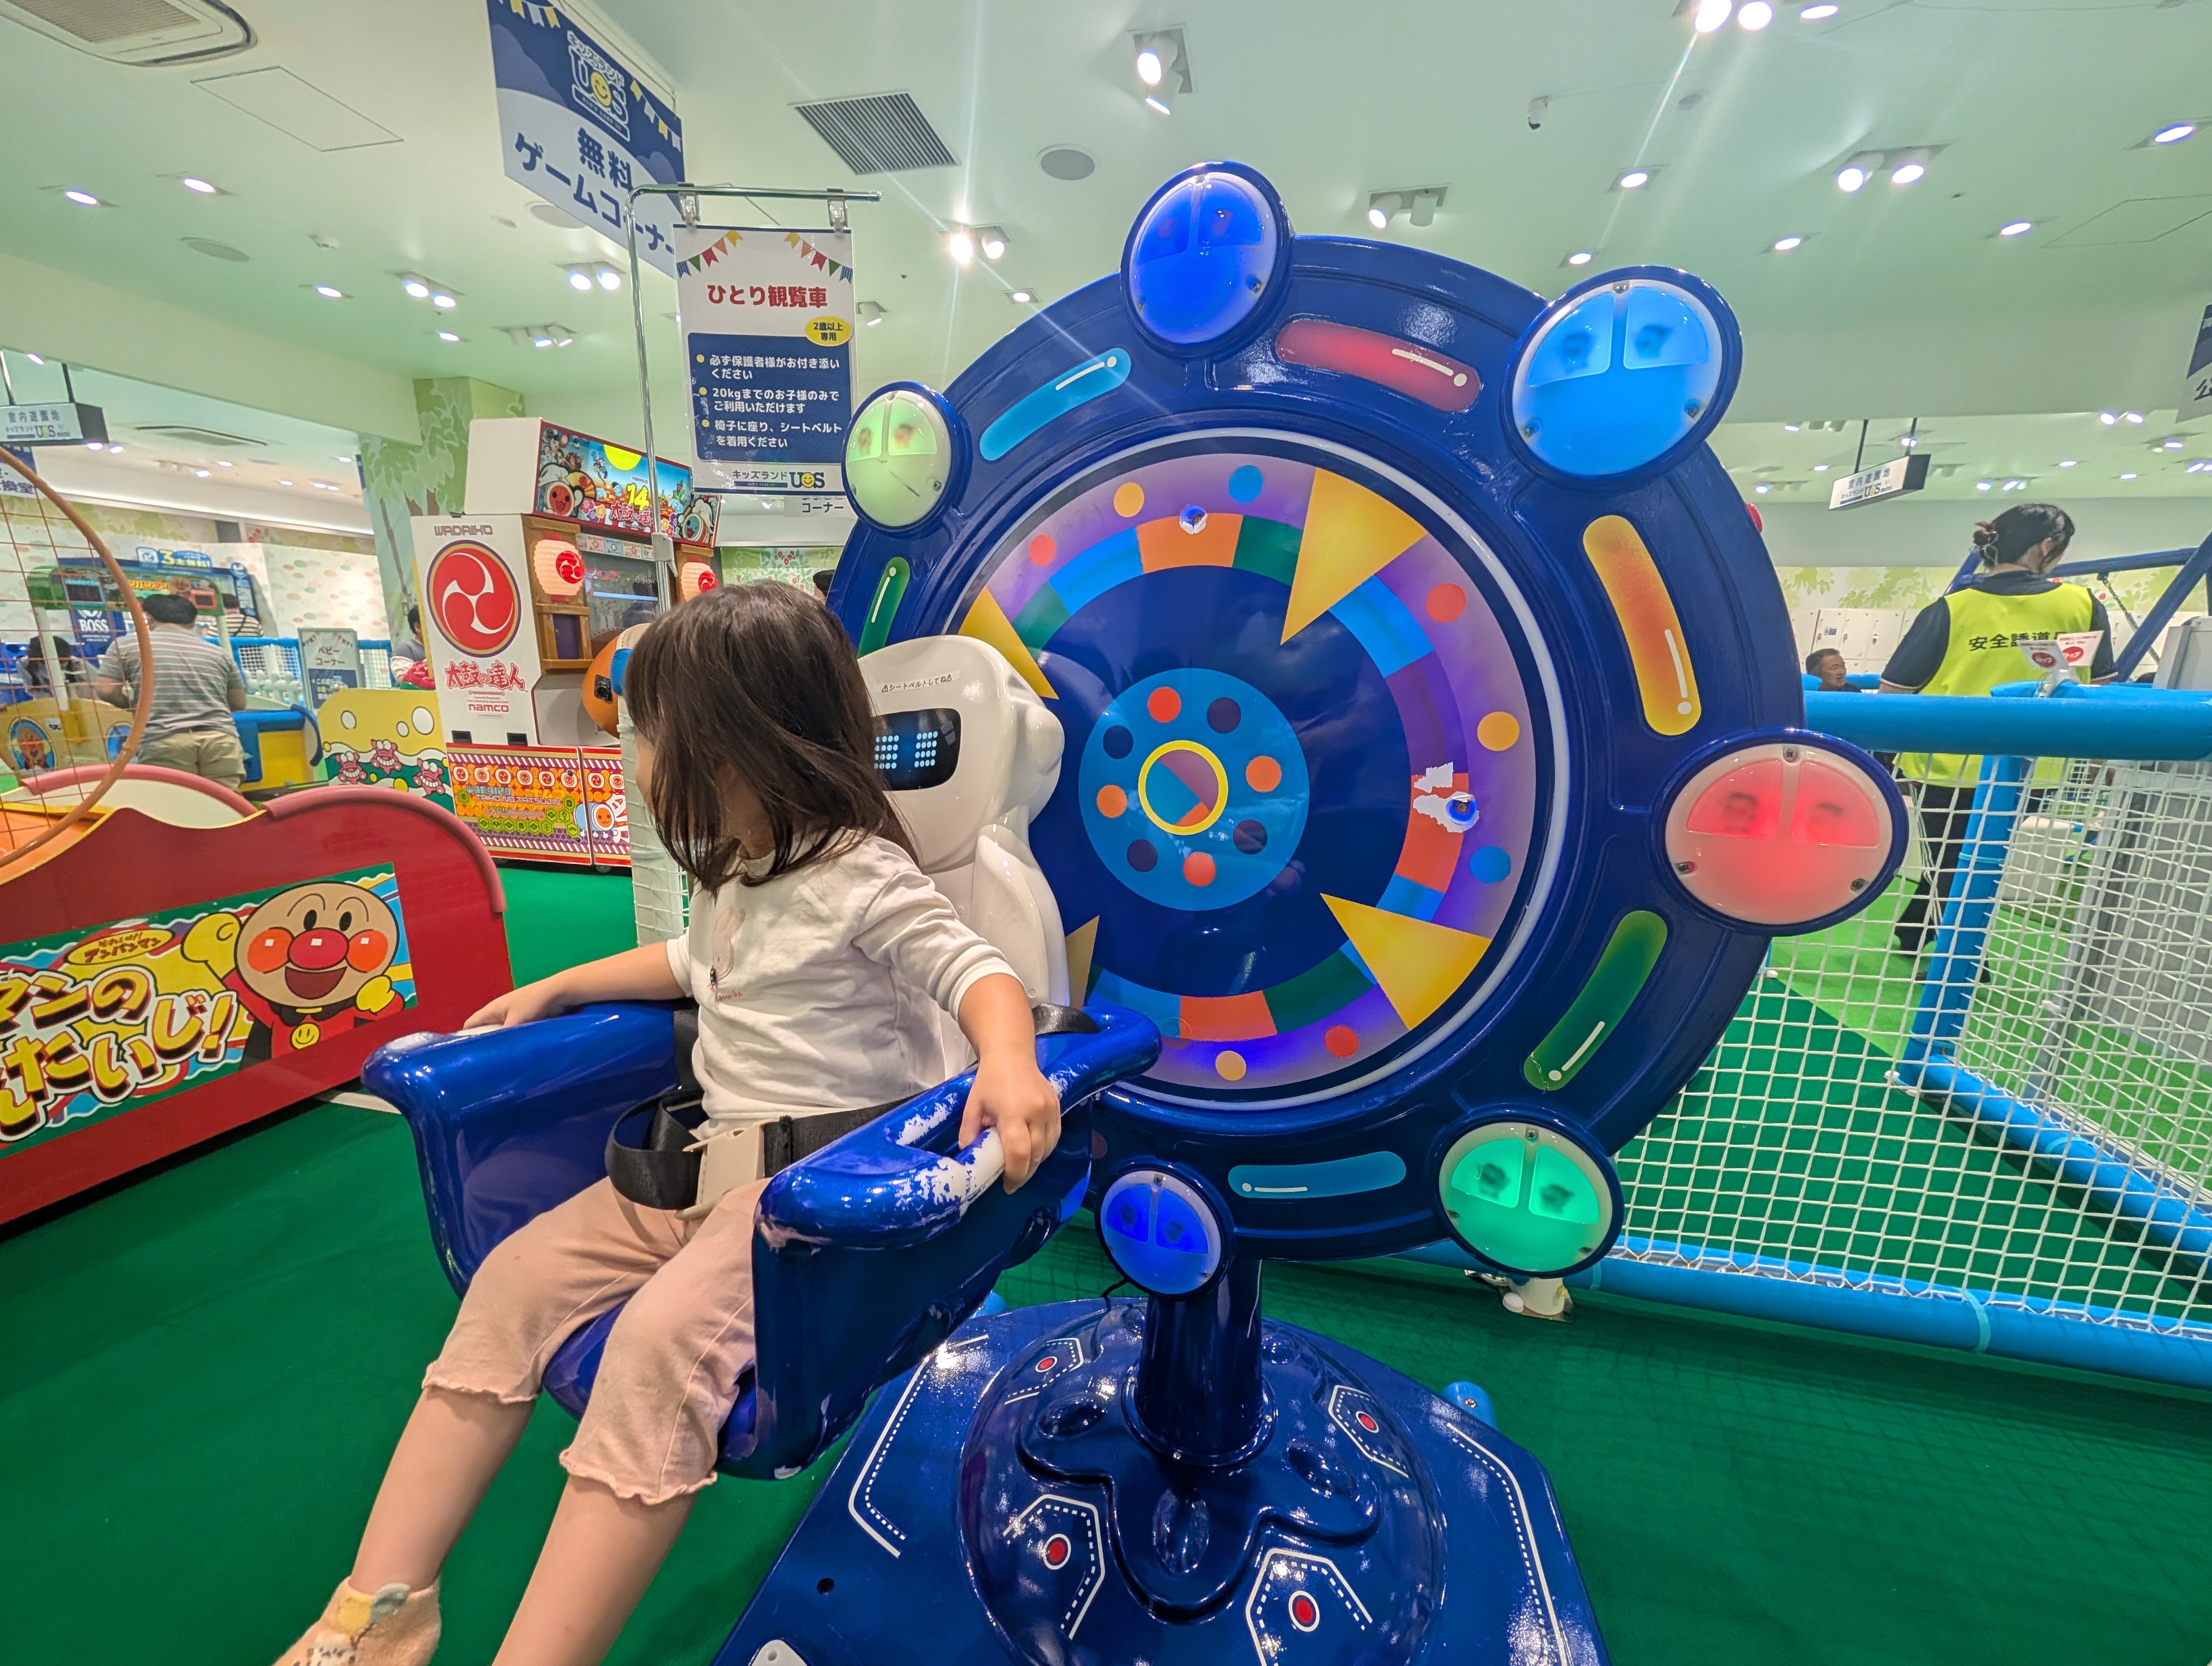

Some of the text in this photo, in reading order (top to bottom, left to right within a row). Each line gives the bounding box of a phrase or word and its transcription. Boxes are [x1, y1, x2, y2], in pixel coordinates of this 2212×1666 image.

[577, 127, 634, 191] 無料
[707, 284, 828, 309] ひとり観覧車
[813, 322, 844, 331] 2歳以上
[820, 332, 837, 341] 専用
[709, 354, 840, 369] 必ず保護者様がお付き添い
[711, 368, 753, 380] ください
[713, 388, 840, 402] 20kgまでのお子様のみで
[714, 401, 806, 414] ご利用いただけます
[715, 420, 842, 433] 椅子に座り、シートベルト
[716, 435, 788, 448] を着用ください
[732, 470, 787, 480] キッズランド
[627, 483, 650, 511] 14
[610, 500, 653, 527] 太鼓の達
[802, 502, 844, 513] コーナー
[434, 524, 493, 536] WADAIKO
[78, 619, 110, 632] BOSS
[1968, 631, 2067, 652] 安全誘導
[445, 659, 525, 691] 太鼓の達人
[889, 676, 947, 691] シートベルトしてね
[468, 704, 509, 713] namco
[516, 797, 561, 806] TATSUJIN
[84, 937, 161, 964] アンパンマン
